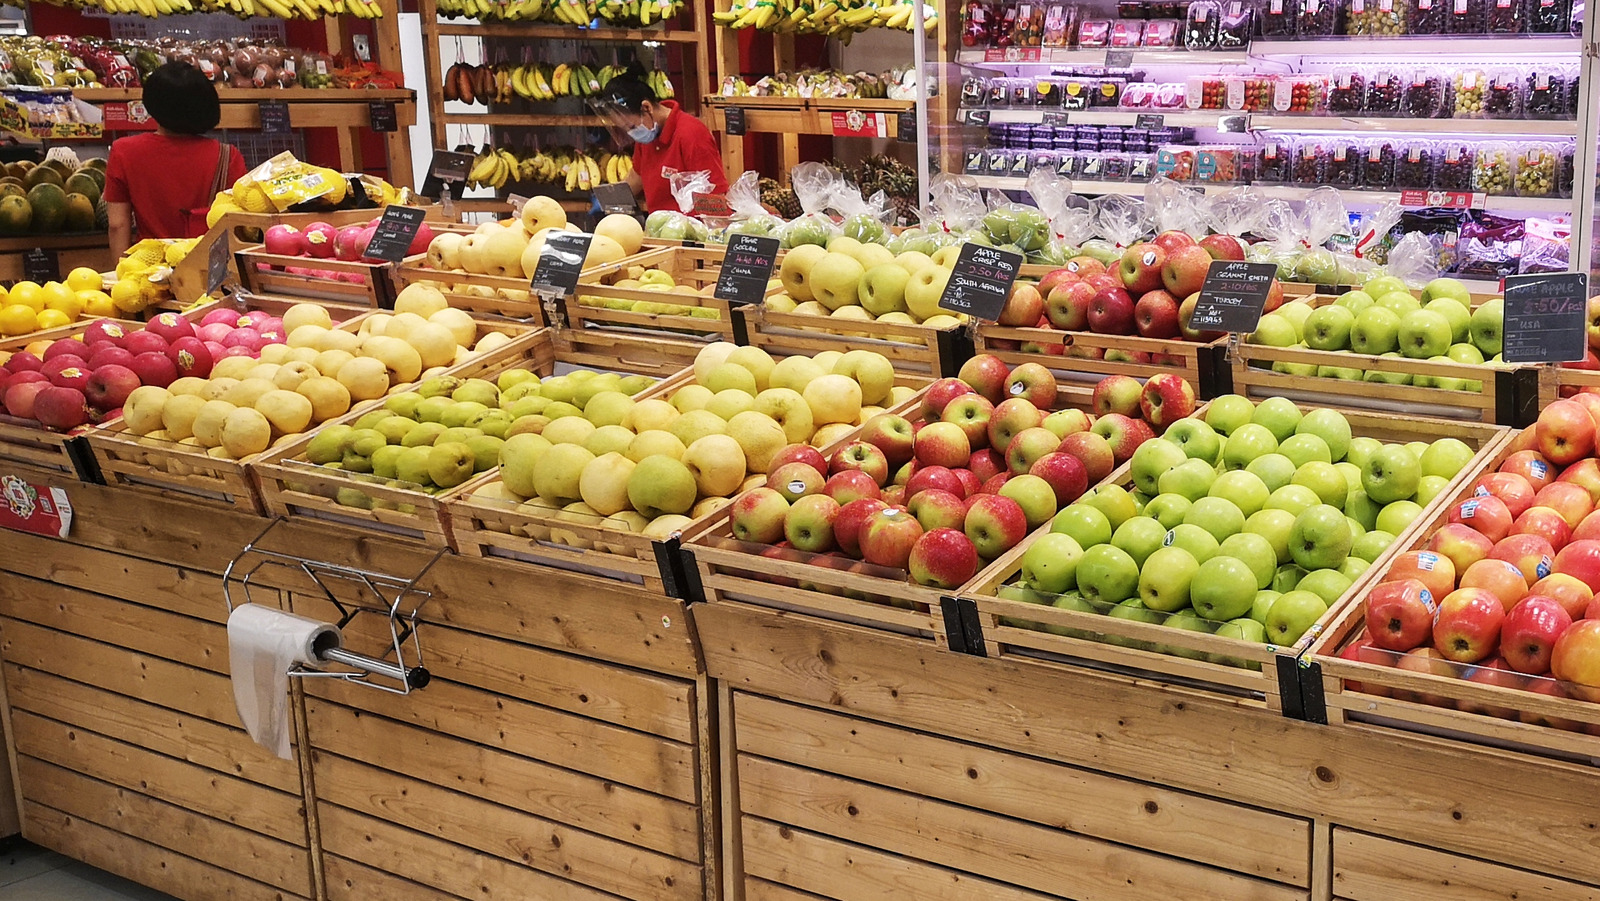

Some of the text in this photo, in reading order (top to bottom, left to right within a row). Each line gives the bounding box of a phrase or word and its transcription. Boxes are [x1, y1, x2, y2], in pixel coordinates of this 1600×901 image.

[974, 248, 1001, 260] APPLE
[972, 256, 1013, 271] CRISP RED
[1225, 263, 1249, 271] APPLE
[969, 266, 991, 276] 2.50
[955, 278, 977, 288] SOUTH
[1541, 283, 1574, 294] APPLE
[1520, 320, 1541, 329] USA
